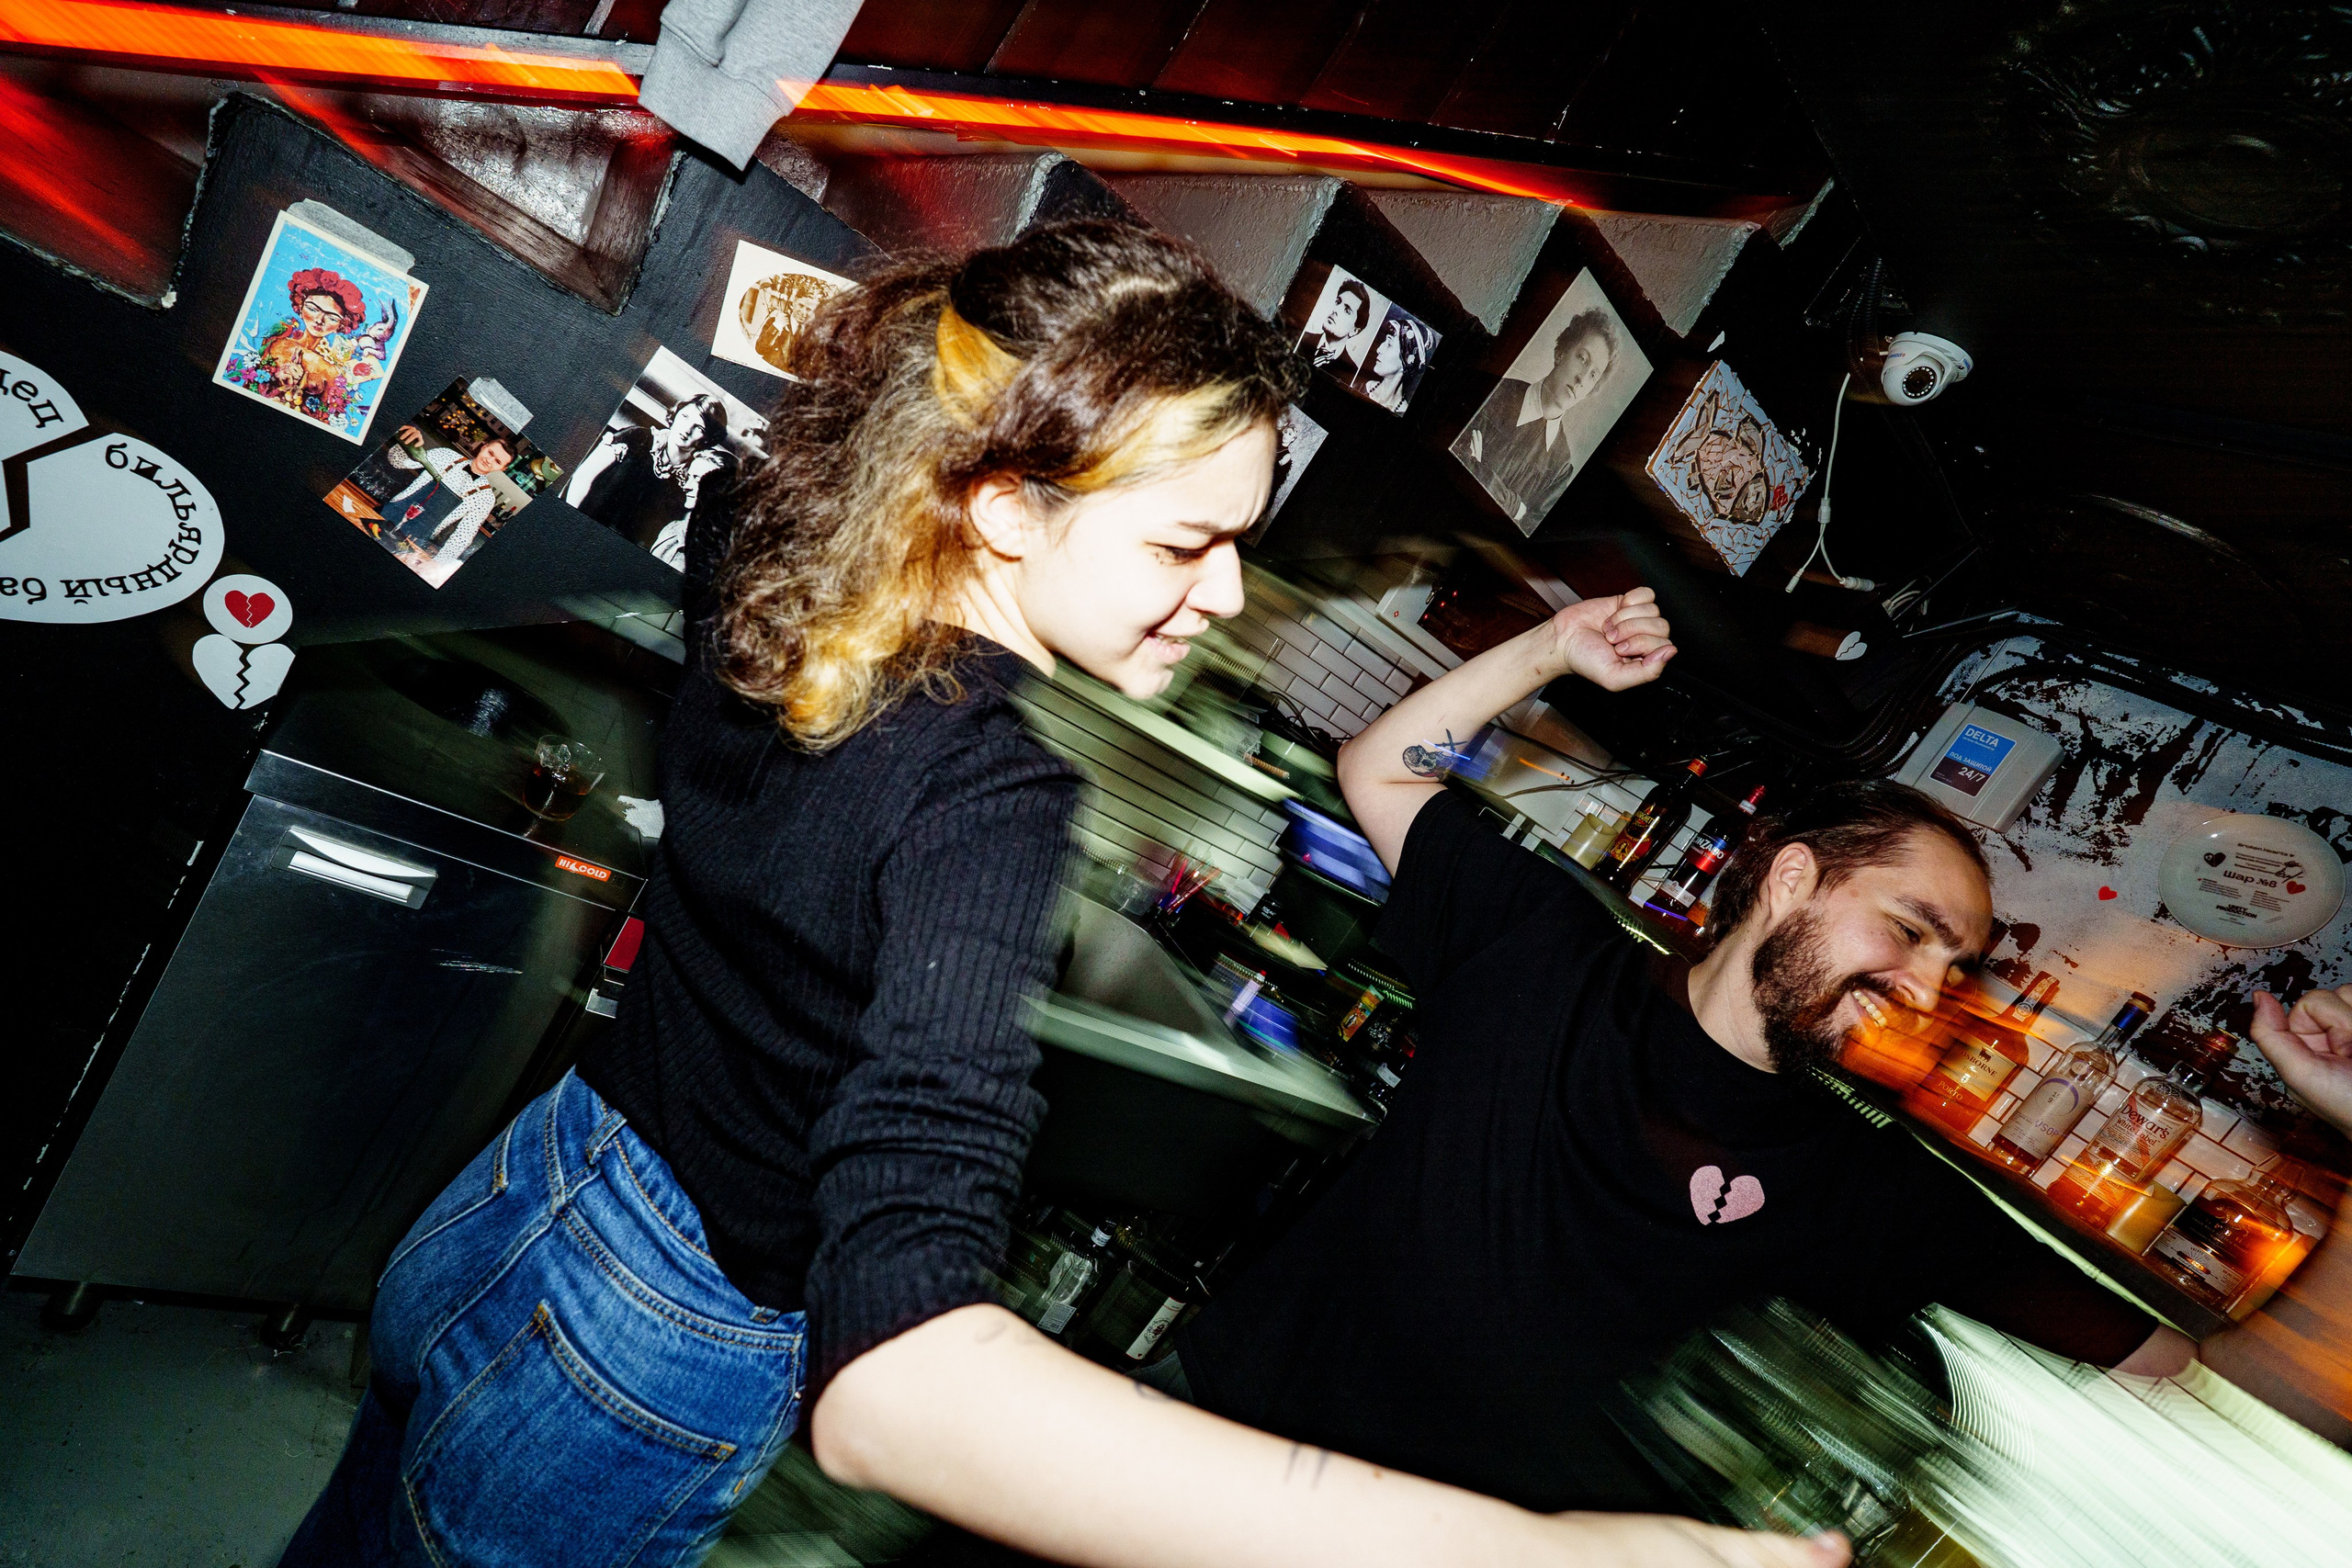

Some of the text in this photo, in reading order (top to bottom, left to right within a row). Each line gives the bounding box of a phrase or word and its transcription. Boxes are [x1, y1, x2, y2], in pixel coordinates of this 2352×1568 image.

[60, 443, 201, 604] бильярдный
[1964, 728, 1999, 748] DELTA
[1949, 751, 1993, 773] ПОД ЗАЩИТОЙ
[1958, 766, 1986, 783] 24/7
[2223, 870, 2255, 884] Шар
[2215, 905, 2257, 919] PRODUCTION
[2228, 904, 2248, 912] UNITY
[1961, 1051, 1998, 1077] OSBORNE
[1938, 1080, 1963, 1100] PORTO
[2034, 1120, 2059, 1138] VSOP
[2120, 1104, 2169, 1139] Dewar's
